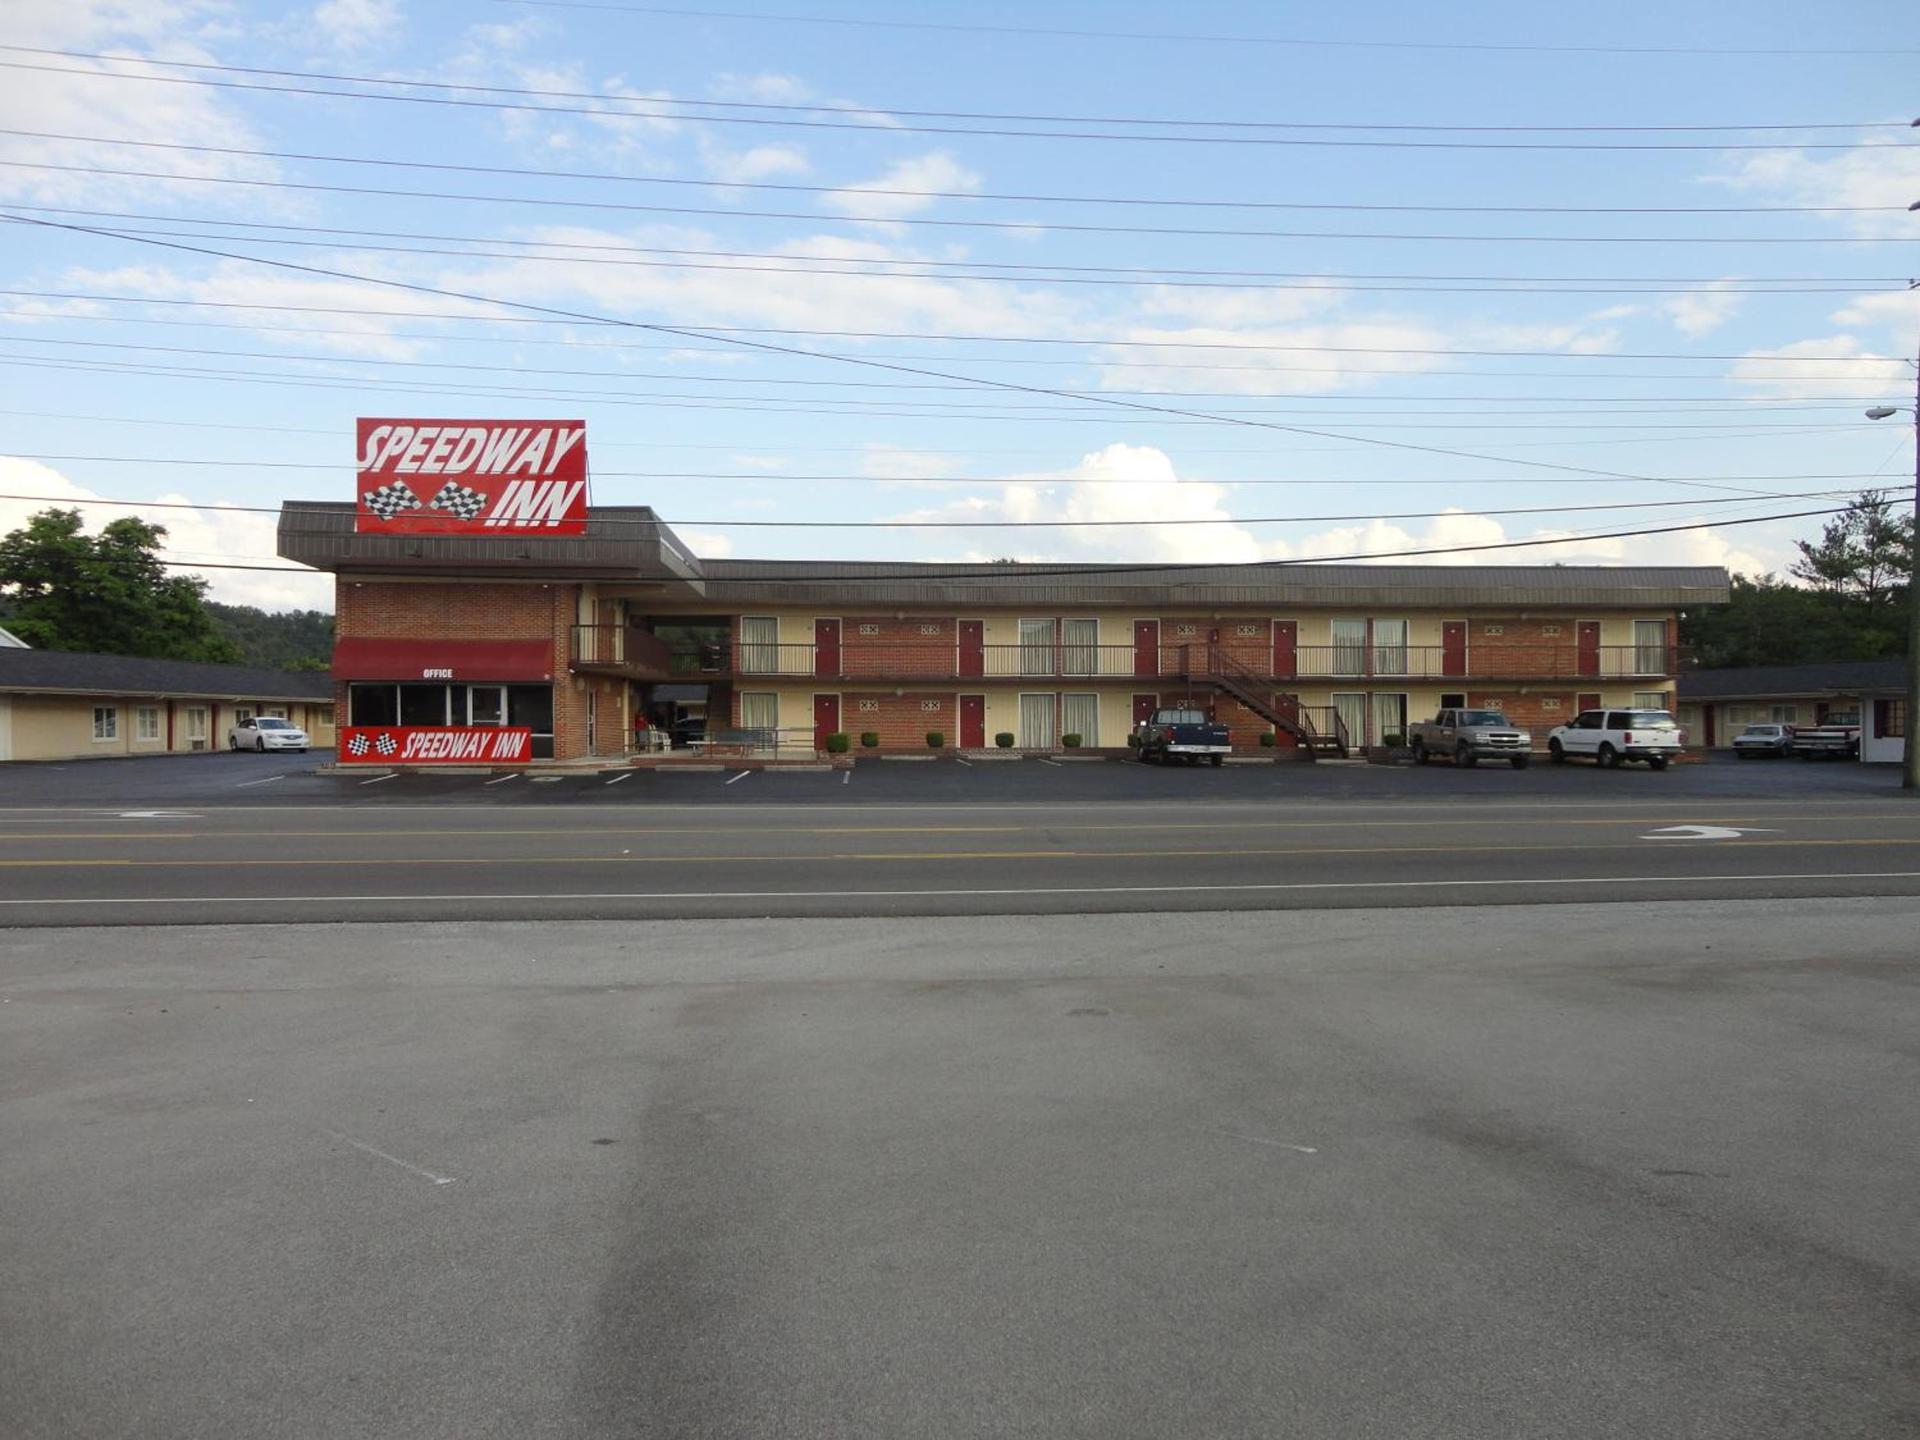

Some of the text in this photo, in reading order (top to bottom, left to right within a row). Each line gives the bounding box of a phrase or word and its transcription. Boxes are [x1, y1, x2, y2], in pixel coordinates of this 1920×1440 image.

[357, 425, 585, 475] SPEEDWAY
[484, 480, 585, 527] INN
[423, 669, 453, 678] OFFICE
[401, 732, 527, 759] SPEEDWAY INN
